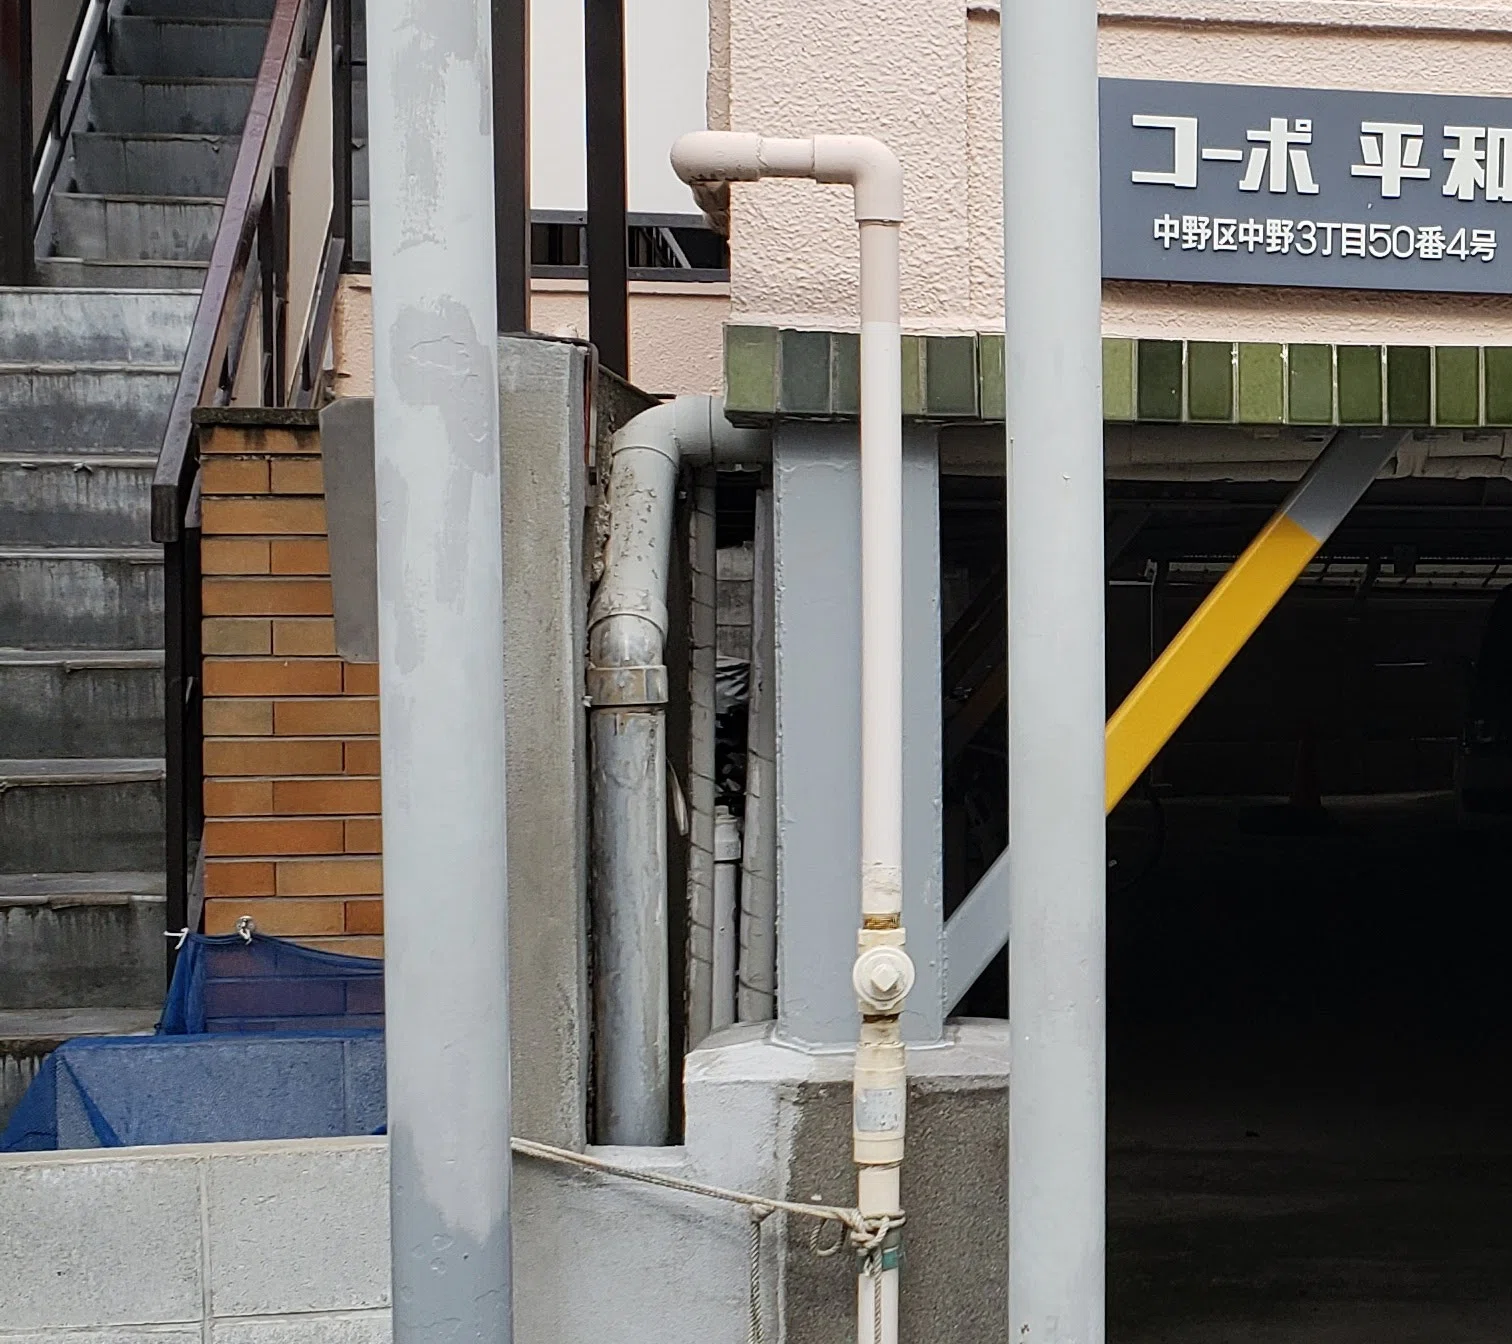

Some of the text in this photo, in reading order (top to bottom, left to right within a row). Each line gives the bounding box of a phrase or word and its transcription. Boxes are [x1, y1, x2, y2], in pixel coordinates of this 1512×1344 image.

[1131, 114, 1320, 194] コーポ
[1153, 213, 1498, 262] 中野区中野3丁目50番4号
